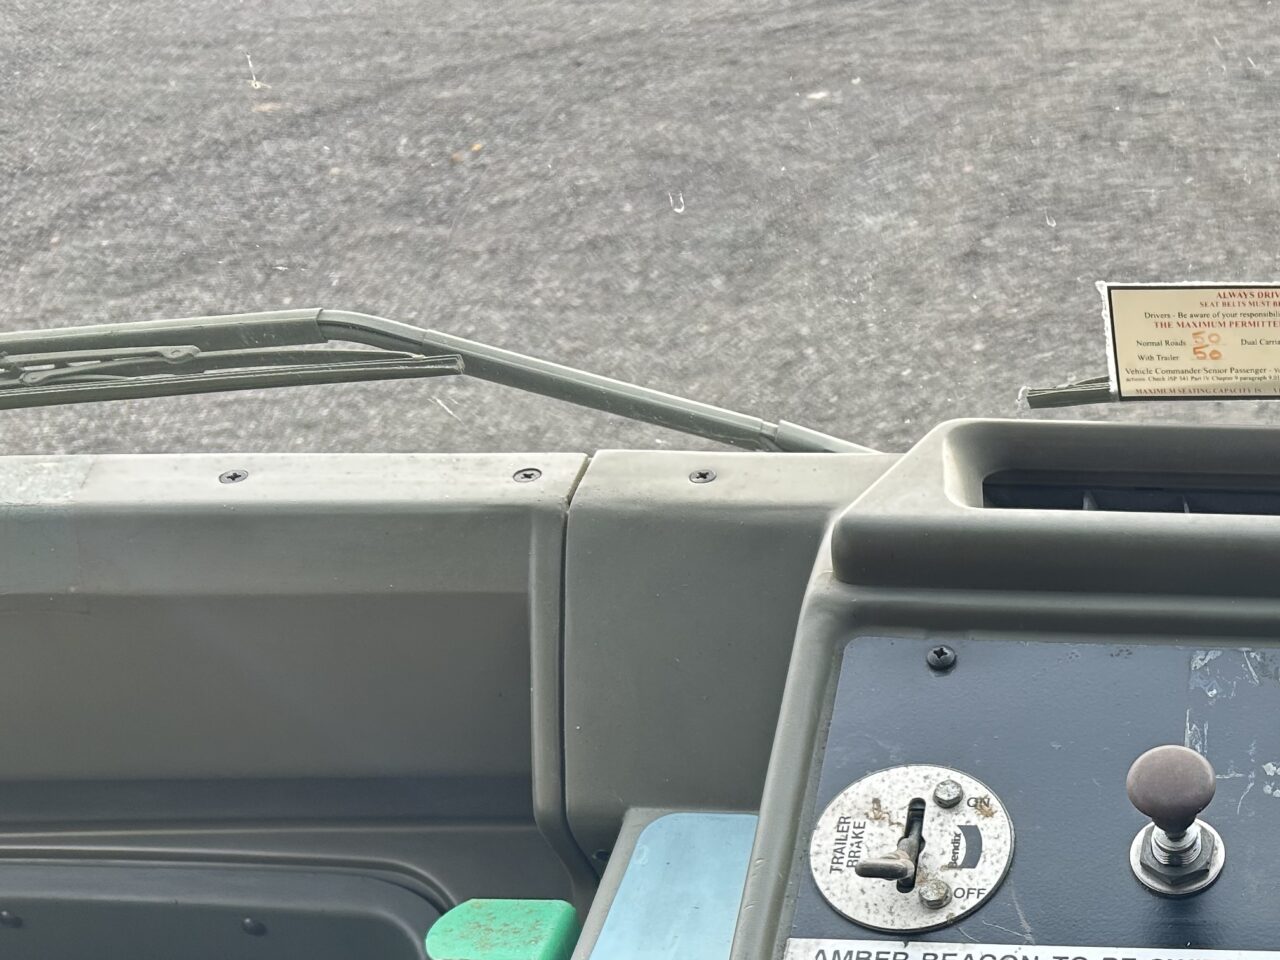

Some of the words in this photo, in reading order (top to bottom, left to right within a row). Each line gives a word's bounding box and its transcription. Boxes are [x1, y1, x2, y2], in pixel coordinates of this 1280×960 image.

[1217, 291, 1255, 299] ALWAYS
[1222, 312, 1238, 320] your
[1176, 321, 1226, 329] MAXIMUM
[1136, 339, 1163, 347] Normal
[1165, 339, 1187, 347] Roads
[1192, 331, 1222, 345] 50
[1193, 344, 1223, 360] 50
[967, 797, 991, 808] ON
[829, 816, 852, 874] TRAILER
[846, 821, 866, 868] BRAKE
[949, 832, 962, 869] Bendix
[953, 888, 986, 900] OFF
